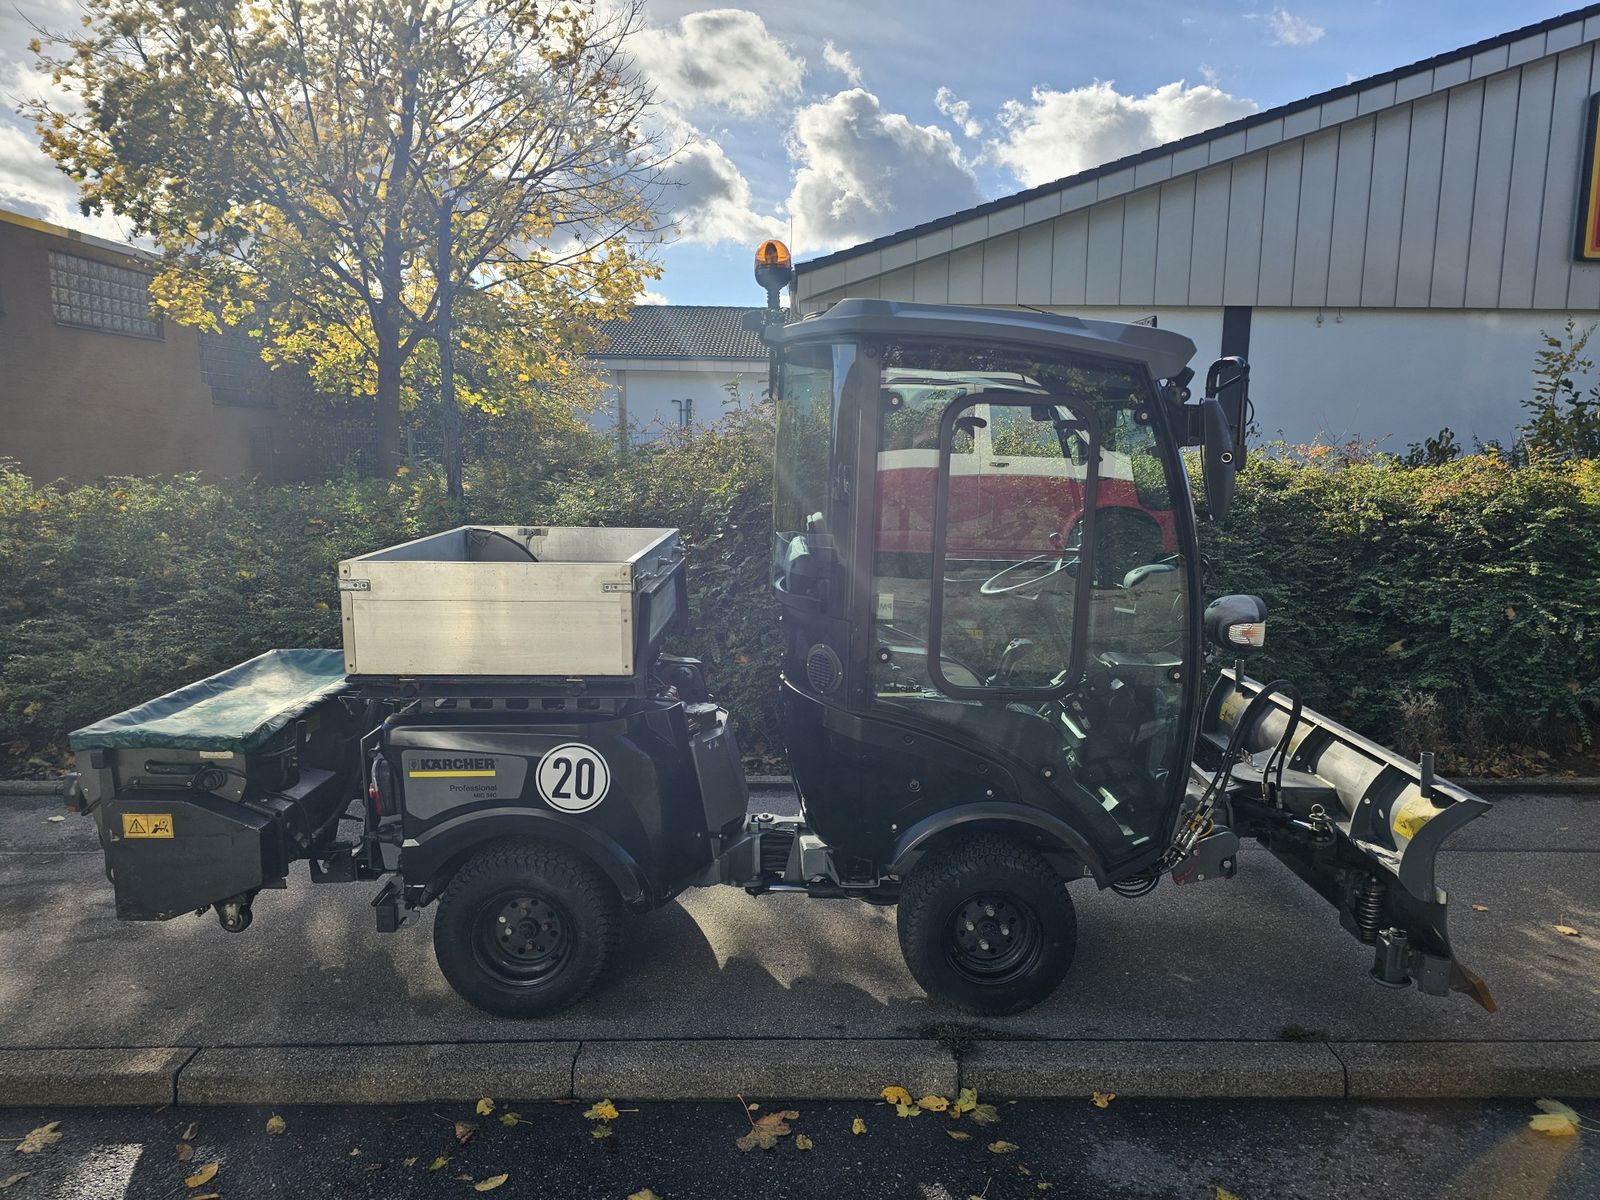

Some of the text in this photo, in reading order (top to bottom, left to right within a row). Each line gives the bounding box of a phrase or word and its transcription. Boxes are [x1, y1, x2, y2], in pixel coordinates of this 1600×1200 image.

[420, 758, 496, 770] KÄRCHER
[552, 757, 595, 801] 20
[449, 784, 497, 792] Professional
